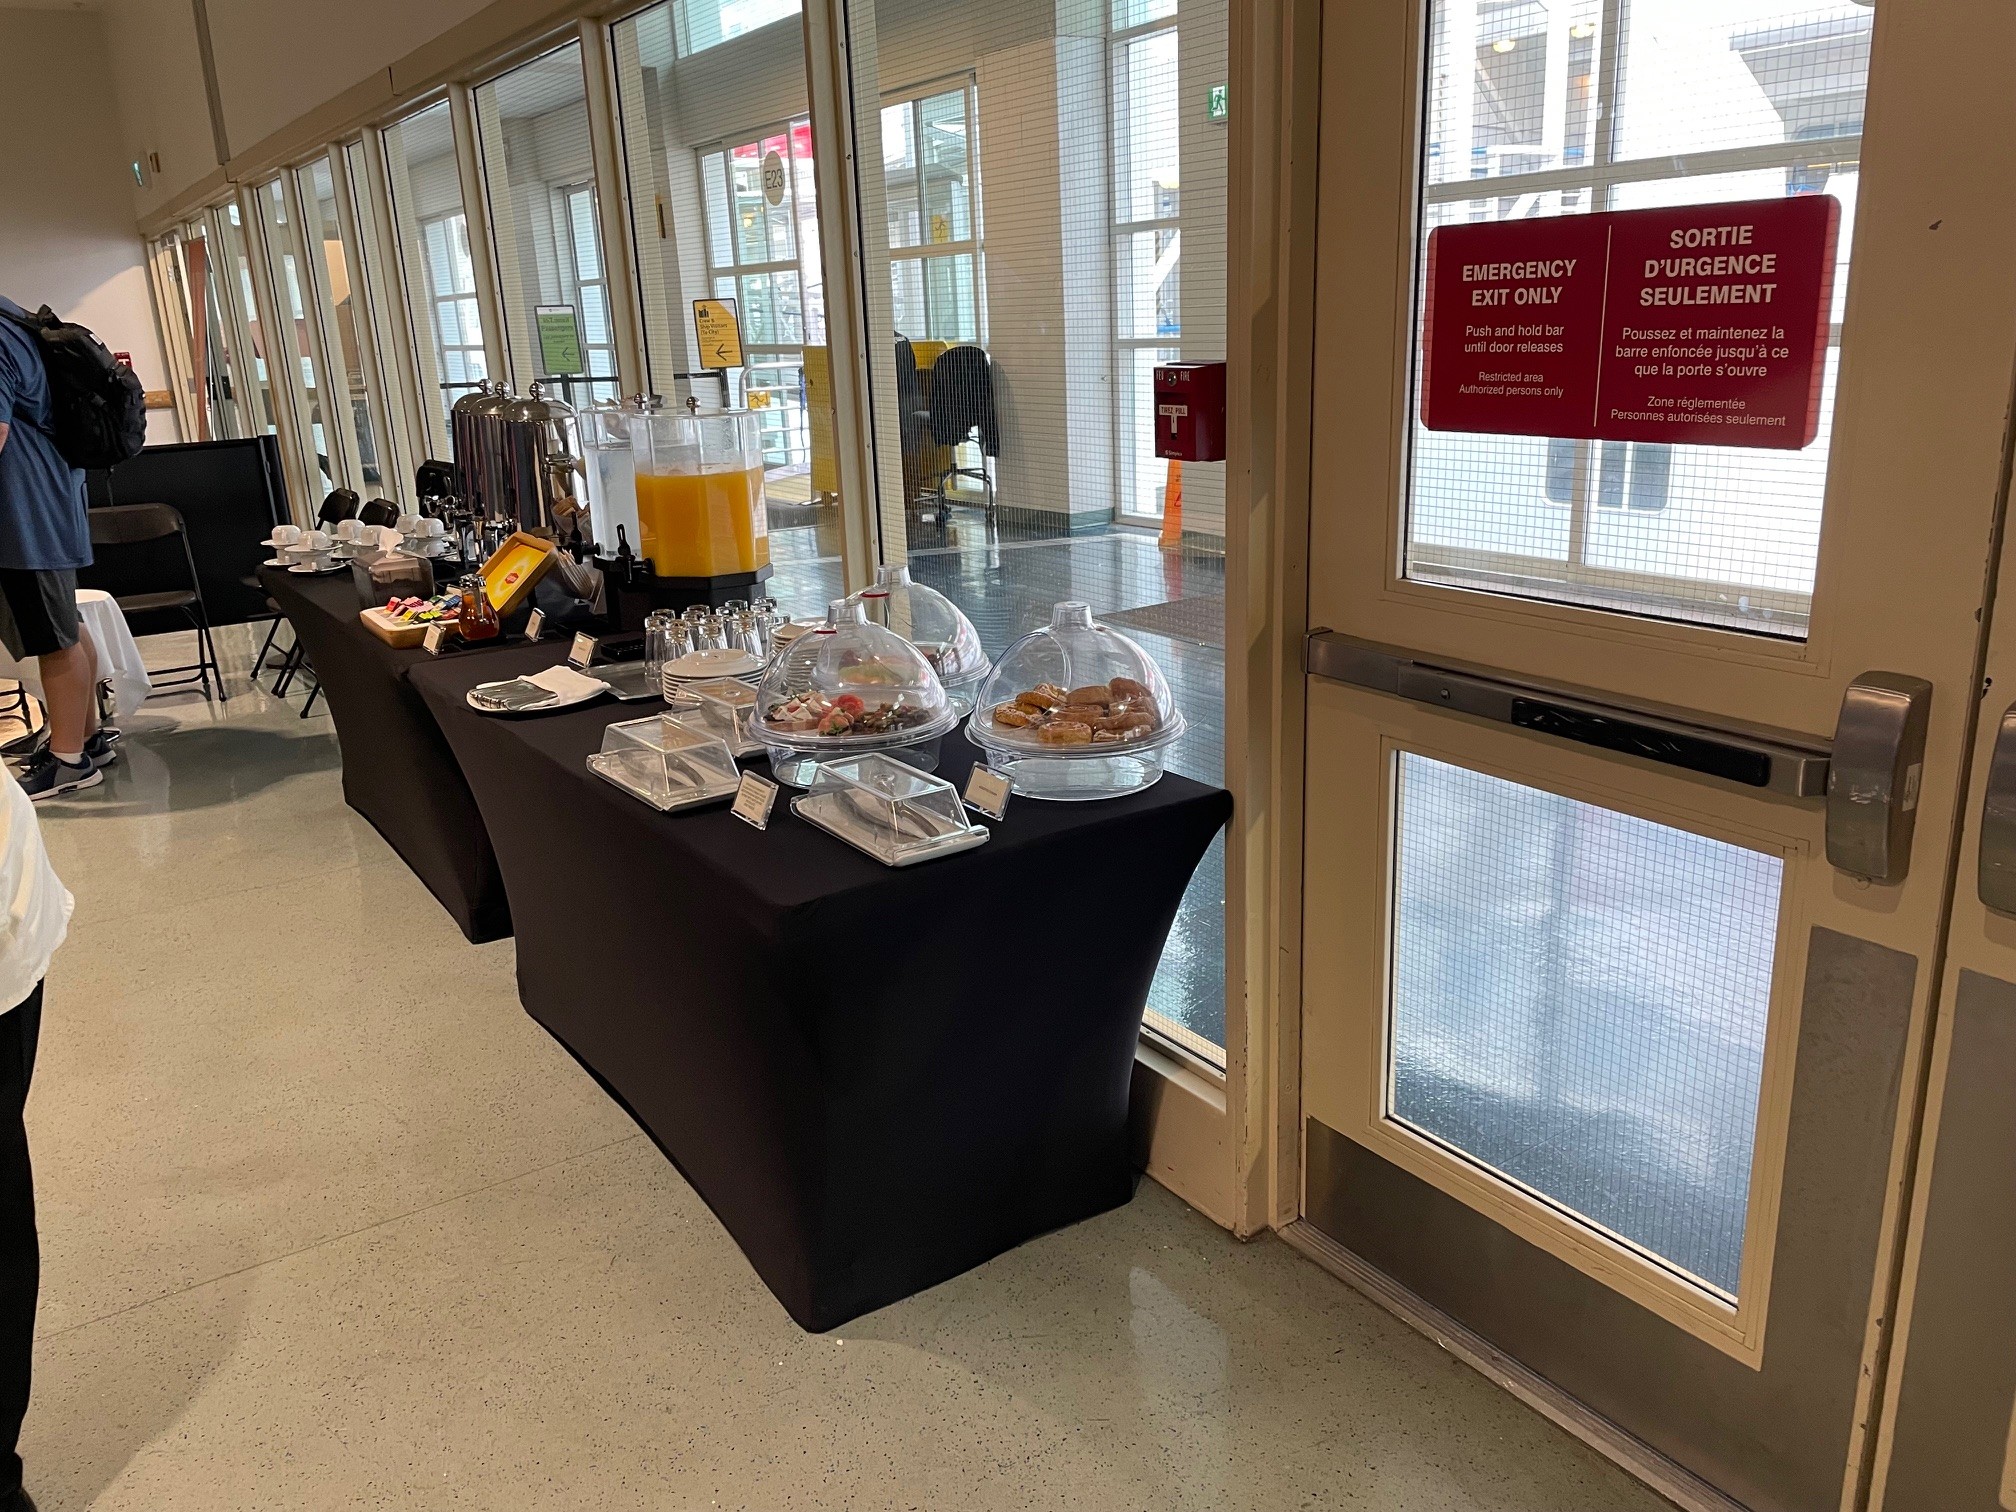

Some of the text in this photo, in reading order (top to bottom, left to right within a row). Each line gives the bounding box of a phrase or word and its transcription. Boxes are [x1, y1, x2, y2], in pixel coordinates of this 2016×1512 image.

[764, 169, 784, 189] E23
[1669, 225, 1754, 249] SORTIE
[1462, 259, 1577, 282] EMERGENCY
[1644, 253, 1777, 278] D'URGENCE
[1471, 286, 1563, 307] EXIT ONLY
[1639, 283, 1778, 307] SEULEMENT
[1465, 324, 1565, 337] Push and hold bar
[1622, 325, 1785, 340] Poussez et maintenez la
[1464, 340, 1564, 353] until door releases
[1615, 343, 1789, 362] barre enfoncée jusqu'à ce
[1180, 370, 1190, 381] FIRE
[1478, 371, 1544, 383] Restricted area
[1634, 362, 1768, 379] que la porte s'ouvre
[1459, 383, 1564, 399] Authorized persons only
[1175, 407, 1186, 415] PULL
[1647, 395, 1746, 411] Zone réglementée
[1610, 408, 1786, 427] Personnes autorisées seulement
